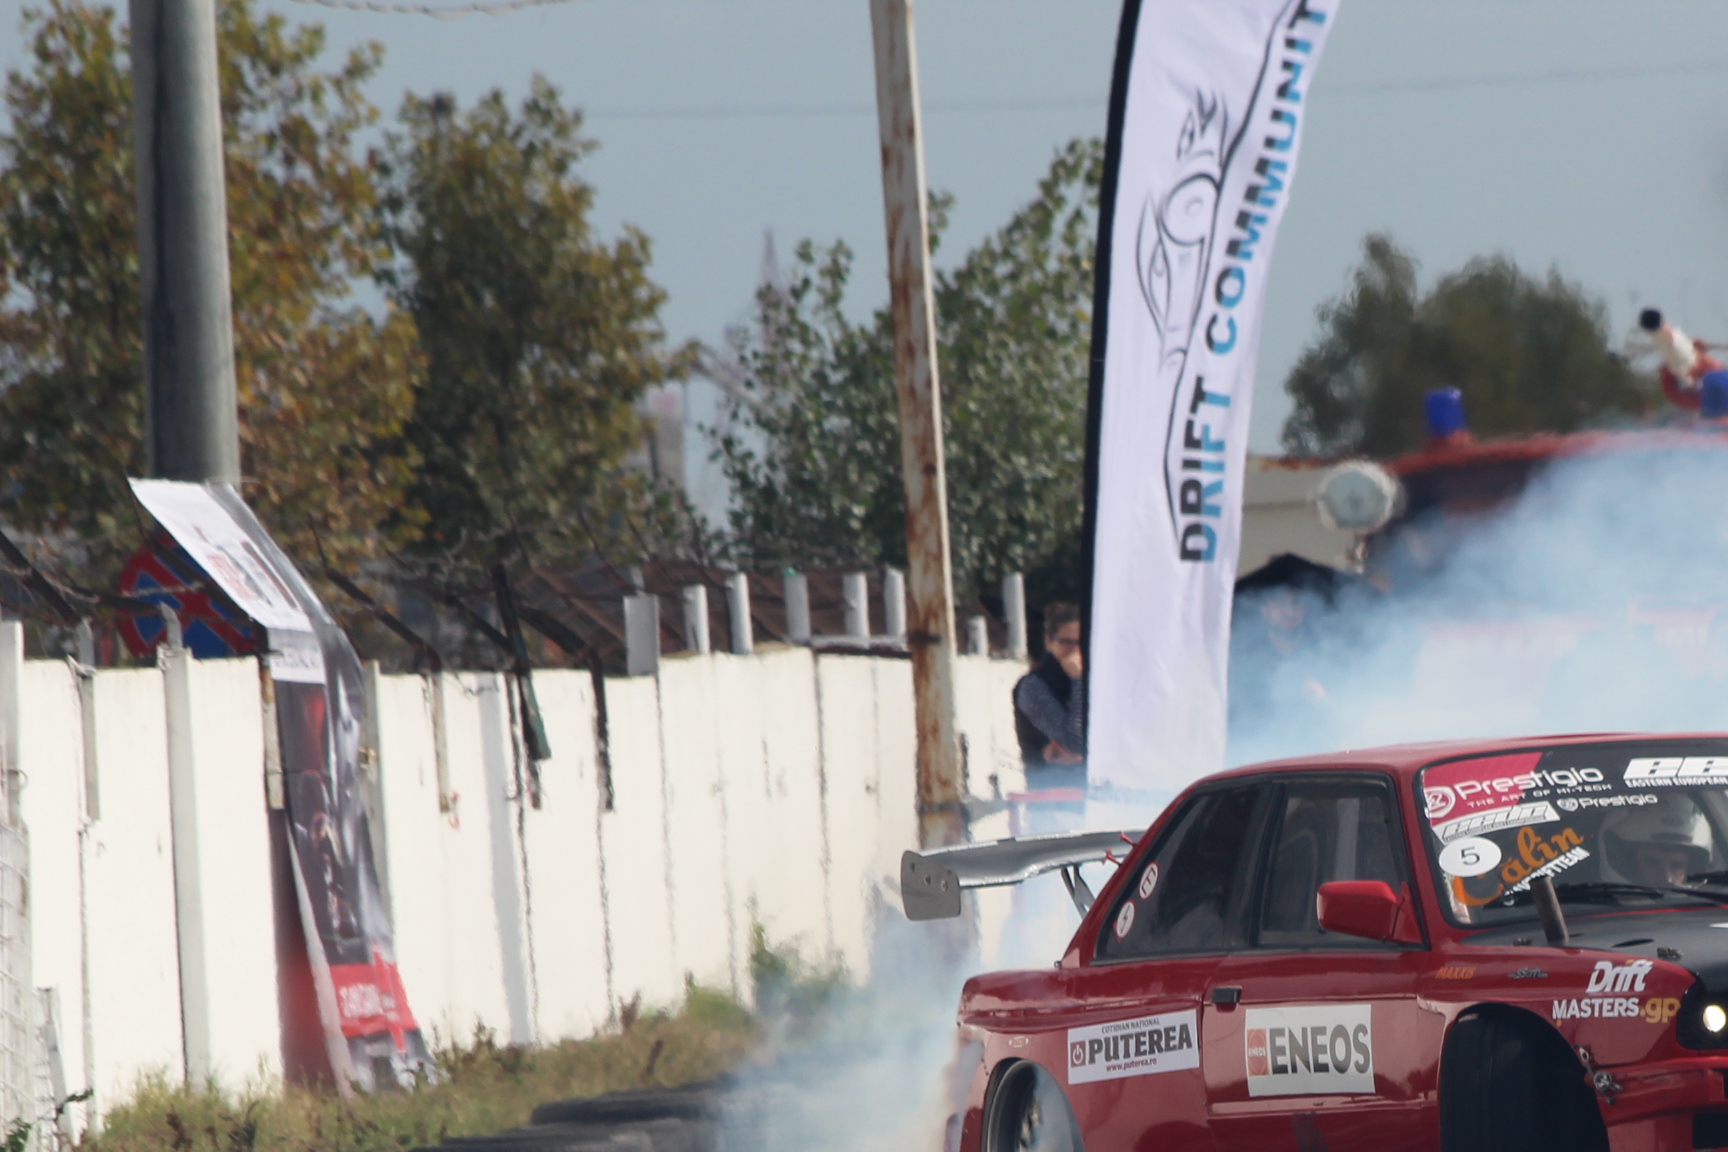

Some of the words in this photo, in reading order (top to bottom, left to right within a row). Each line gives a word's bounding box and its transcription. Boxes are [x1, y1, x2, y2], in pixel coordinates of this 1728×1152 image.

[1205, 0, 1327, 355] COMMUNIT
[1180, 375, 1232, 563] DRIFT
[1454, 767, 1605, 799] Prestigio
[1625, 777, 1673, 788] EASTERN
[1673, 776, 1728, 786] EUROPEAN
[1467, 798, 1495, 809] THE
[1501, 790, 1527, 802] ART
[1533, 788, 1551, 798] OF
[1557, 783, 1612, 795] HI-TECH
[1578, 793, 1658, 809] Prestigio
[1460, 846, 1481, 866] 5
[1435, 966, 1477, 980] MAXXIS
[1585, 959, 1654, 993] Drift
[1101, 1023, 1130, 1034] COTIDIAN
[1088, 1023, 1192, 1065] PUTEREA
[1248, 1047, 1266, 1057] ENEOS
[1269, 1023, 1370, 1075] ENEOS
[1106, 1058, 1157, 1072] www.puterea.ro
